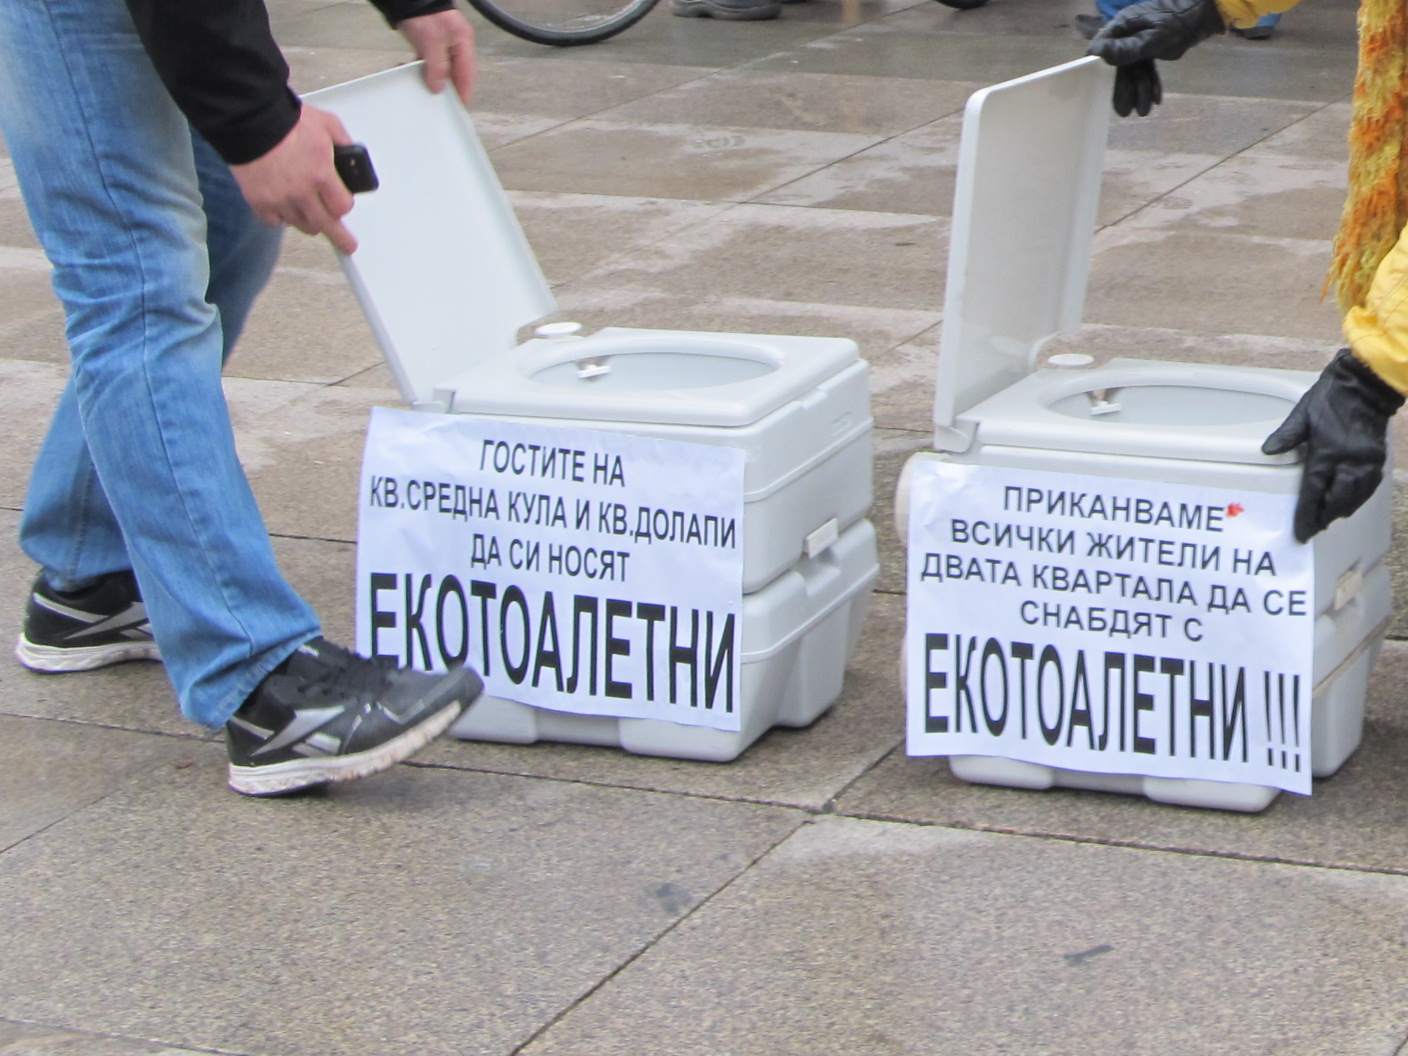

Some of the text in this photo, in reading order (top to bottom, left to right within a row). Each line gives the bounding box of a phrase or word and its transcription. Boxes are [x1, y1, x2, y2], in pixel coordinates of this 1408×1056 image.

[480, 439, 625, 487] ГОСТИТЕ НА
[508, 491, 567, 528] КУЛА
[575, 500, 590, 530] И
[1004, 486, 1224, 532] ПРИКАНВАМЕ
[471, 534, 630, 582] ДА СИ НОСЯТ
[952, 519, 1277, 576] ВСИЧКИ ЖИТЕЛИ НА
[920, 553, 1307, 616] ДВАТА КВАРТАЛА ДА СЕ
[370, 572, 735, 713] ЕКОТОАЛЕТНИ
[1020, 600, 1204, 642] СНАБДЯТ С
[924, 633, 1249, 763] ЕКОТОАЛЕТНИ
